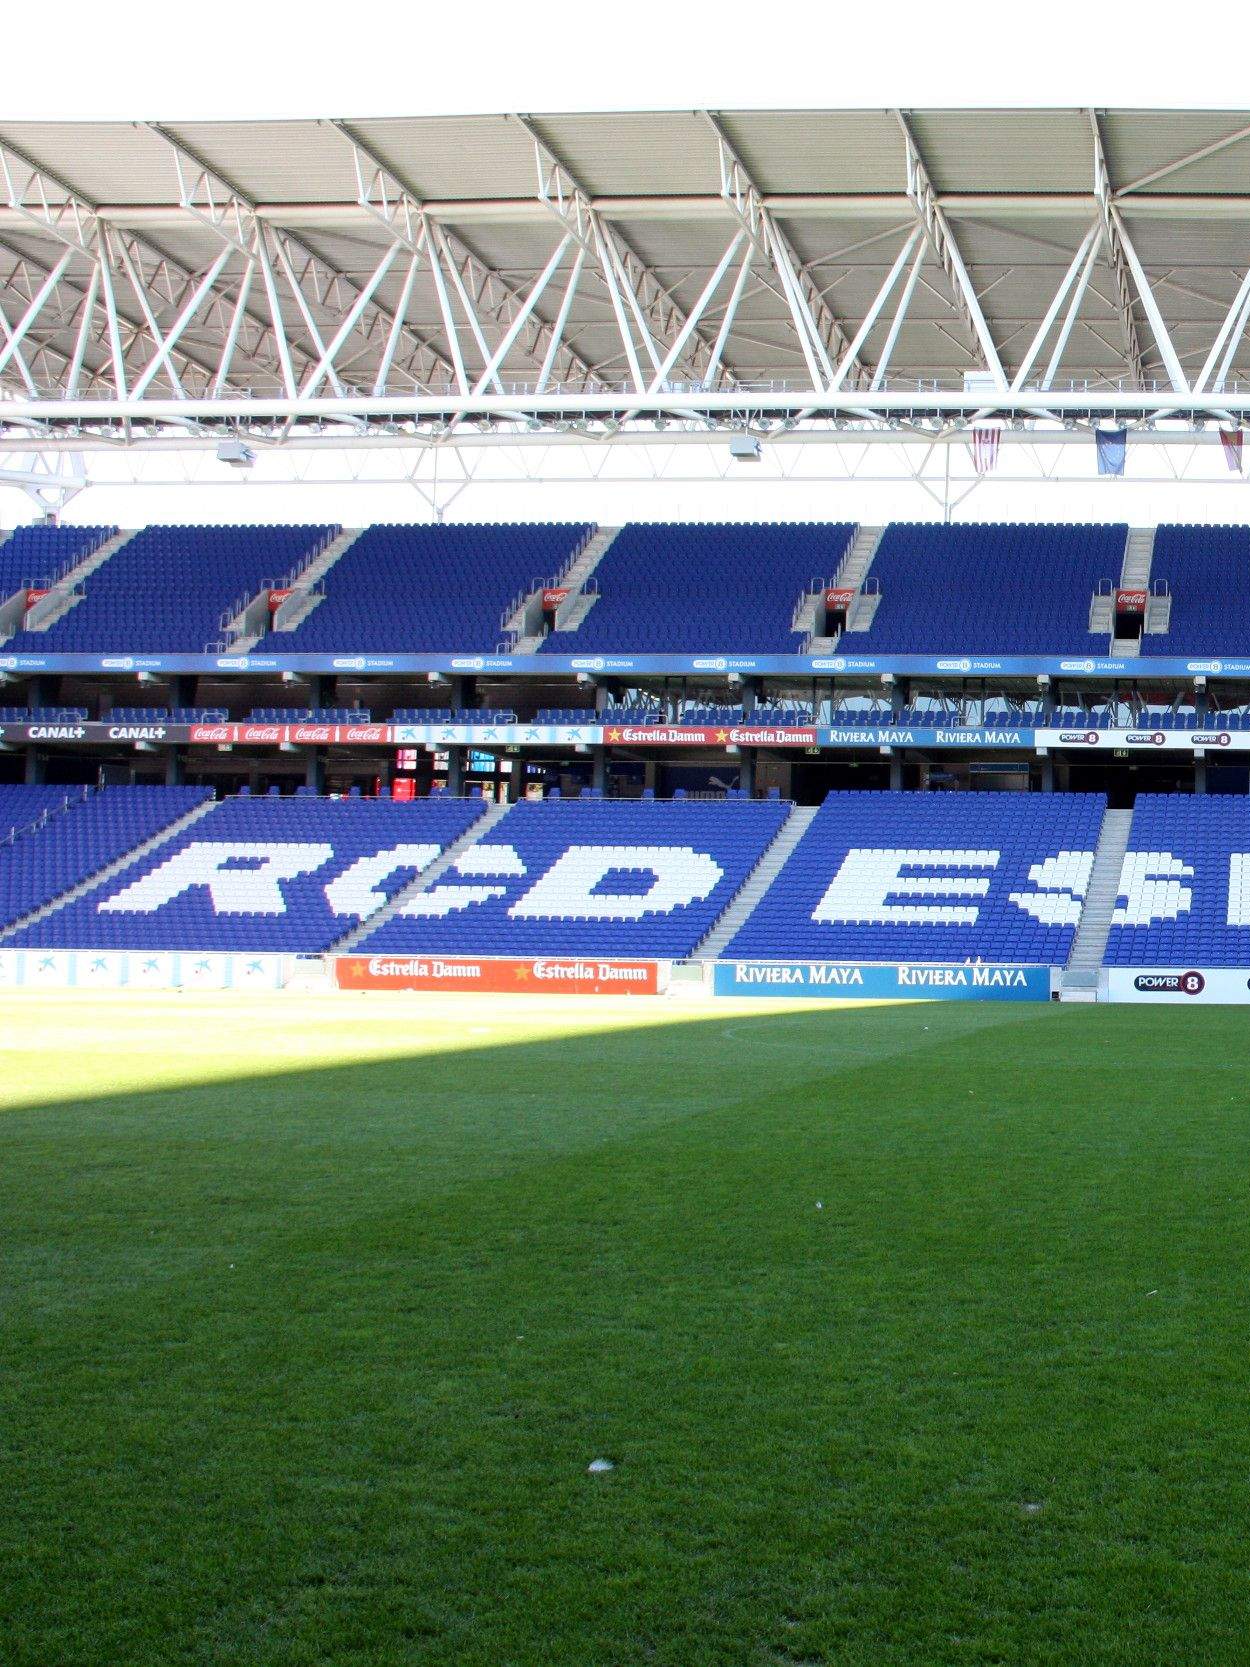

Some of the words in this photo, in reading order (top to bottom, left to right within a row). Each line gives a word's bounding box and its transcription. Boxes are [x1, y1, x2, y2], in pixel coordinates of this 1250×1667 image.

[28, 726, 86, 738] CANAL+
[109, 727, 166, 739] CANAL+
[622, 728, 668, 742] Estrella
[668, 730, 706, 742] Damm
[730, 729, 774, 743] Estrella
[776, 730, 814, 743] Damm
[830, 730, 875, 743] RIVIERA
[878, 730, 914, 743] MAYA
[936, 730, 982, 744] RIVIERA
[984, 731, 1020, 744] MAYA
[368, 960, 428, 978] Estrella
[432, 961, 481, 978] Damm
[532, 961, 594, 980] Estrella
[598, 963, 648, 981] Damm
[736, 965, 804, 984] RIVIERA
[809, 966, 864, 985] MAYA
[898, 967, 968, 985] RIVIERA
[972, 968, 1027, 986] MAYA
